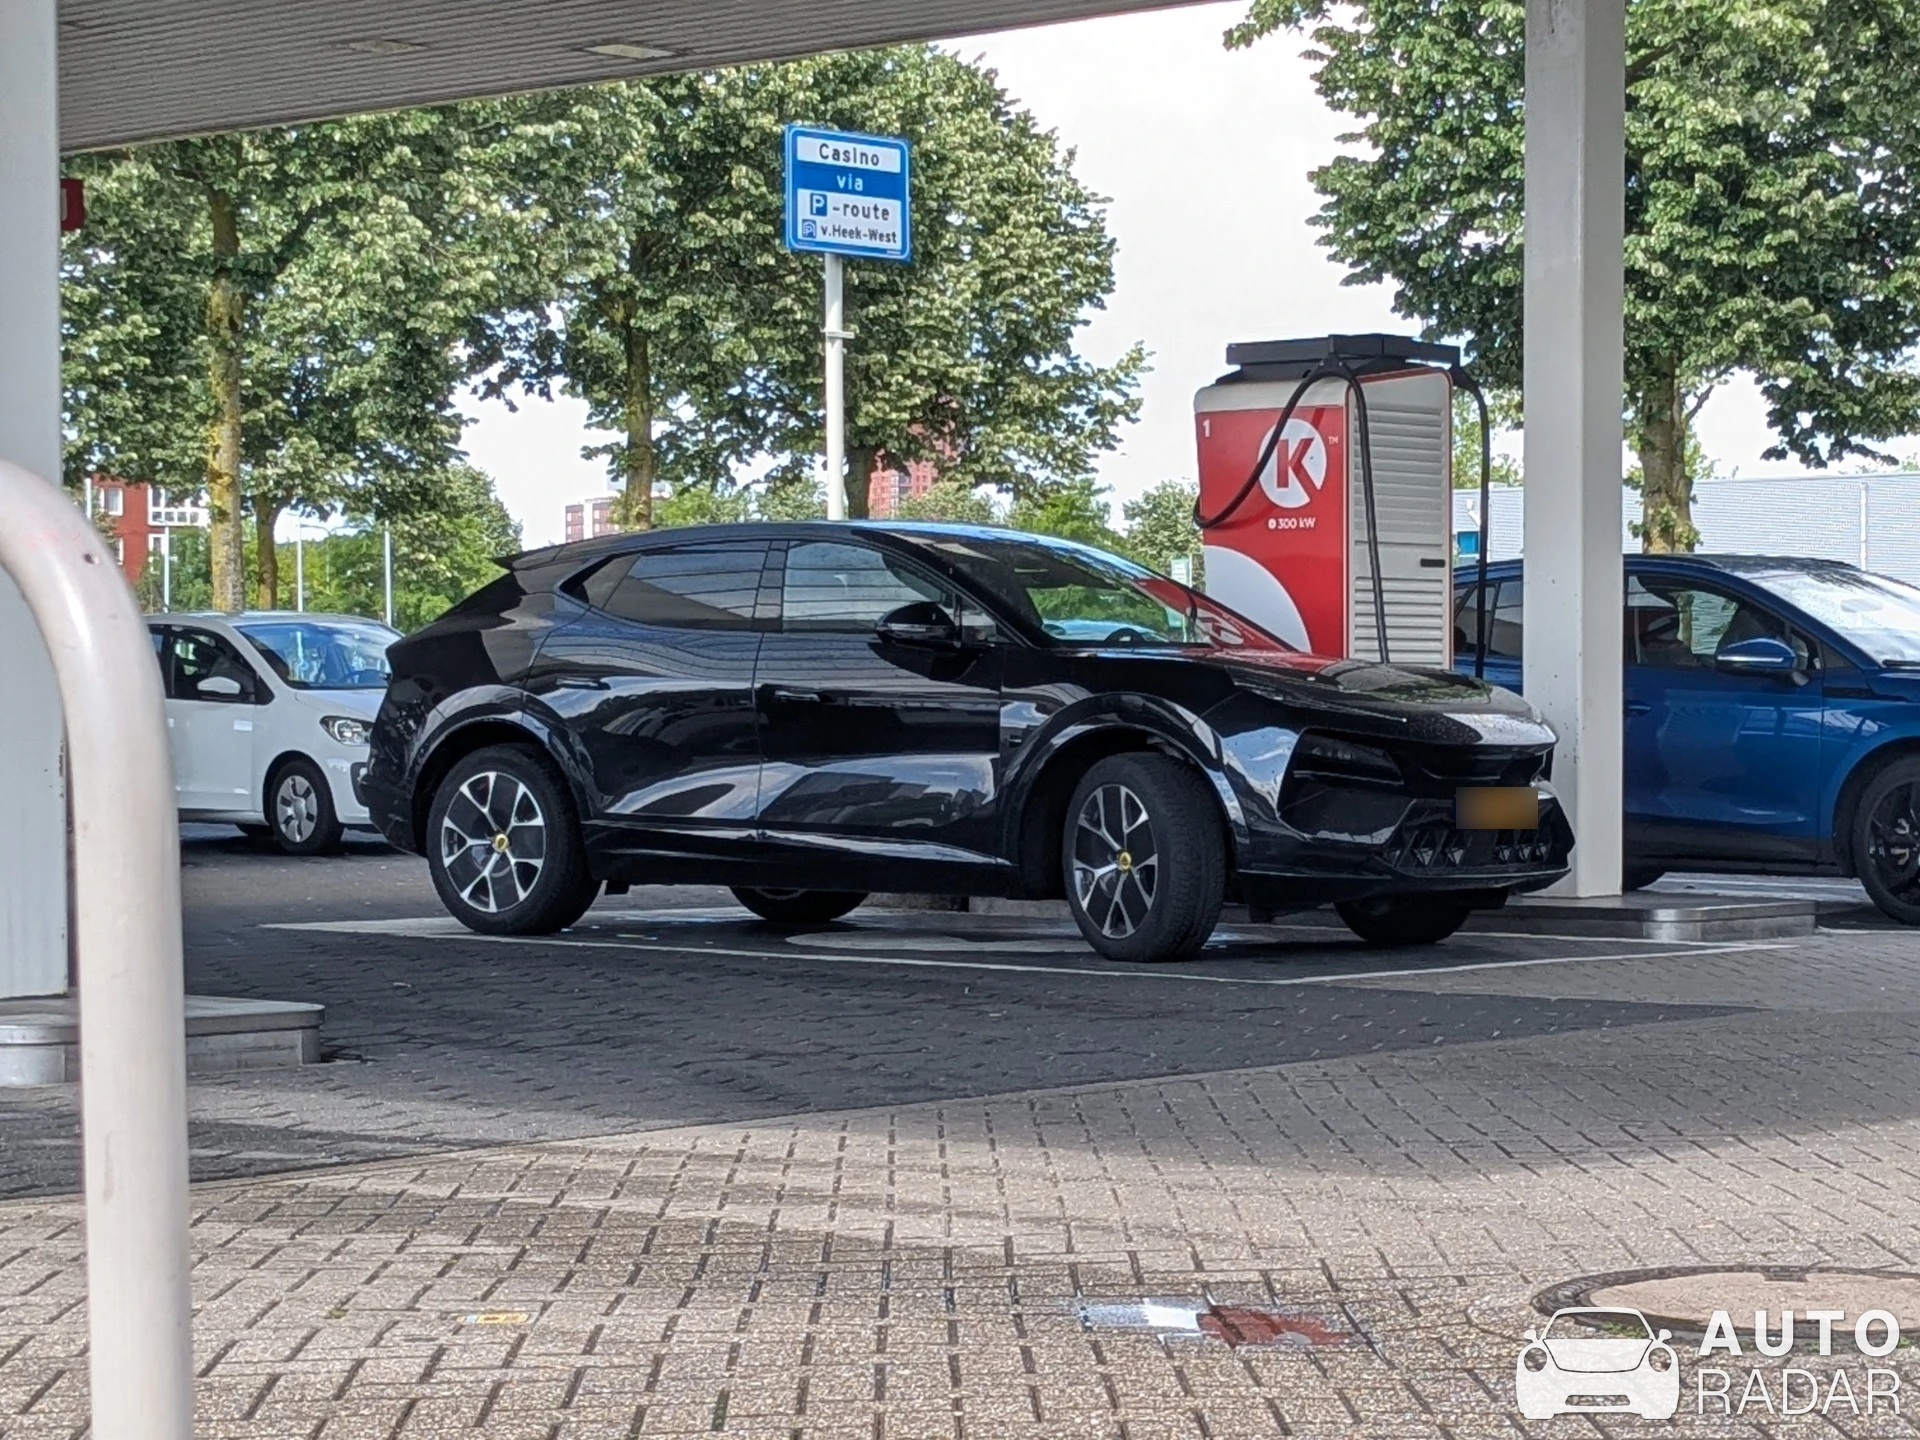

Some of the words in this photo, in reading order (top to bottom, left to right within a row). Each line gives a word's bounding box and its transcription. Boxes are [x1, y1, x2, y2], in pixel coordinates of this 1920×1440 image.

[819, 143, 880, 166] Casino
[836, 173, 864, 191] via
[812, 195, 825, 214] P
[820, 224, 897, 244] v.Heek-West
[1203, 419, 1211, 438] 1
[1276, 437, 1319, 502] K
[1277, 518, 1297, 530] 300
[1298, 517, 1316, 529] kW
